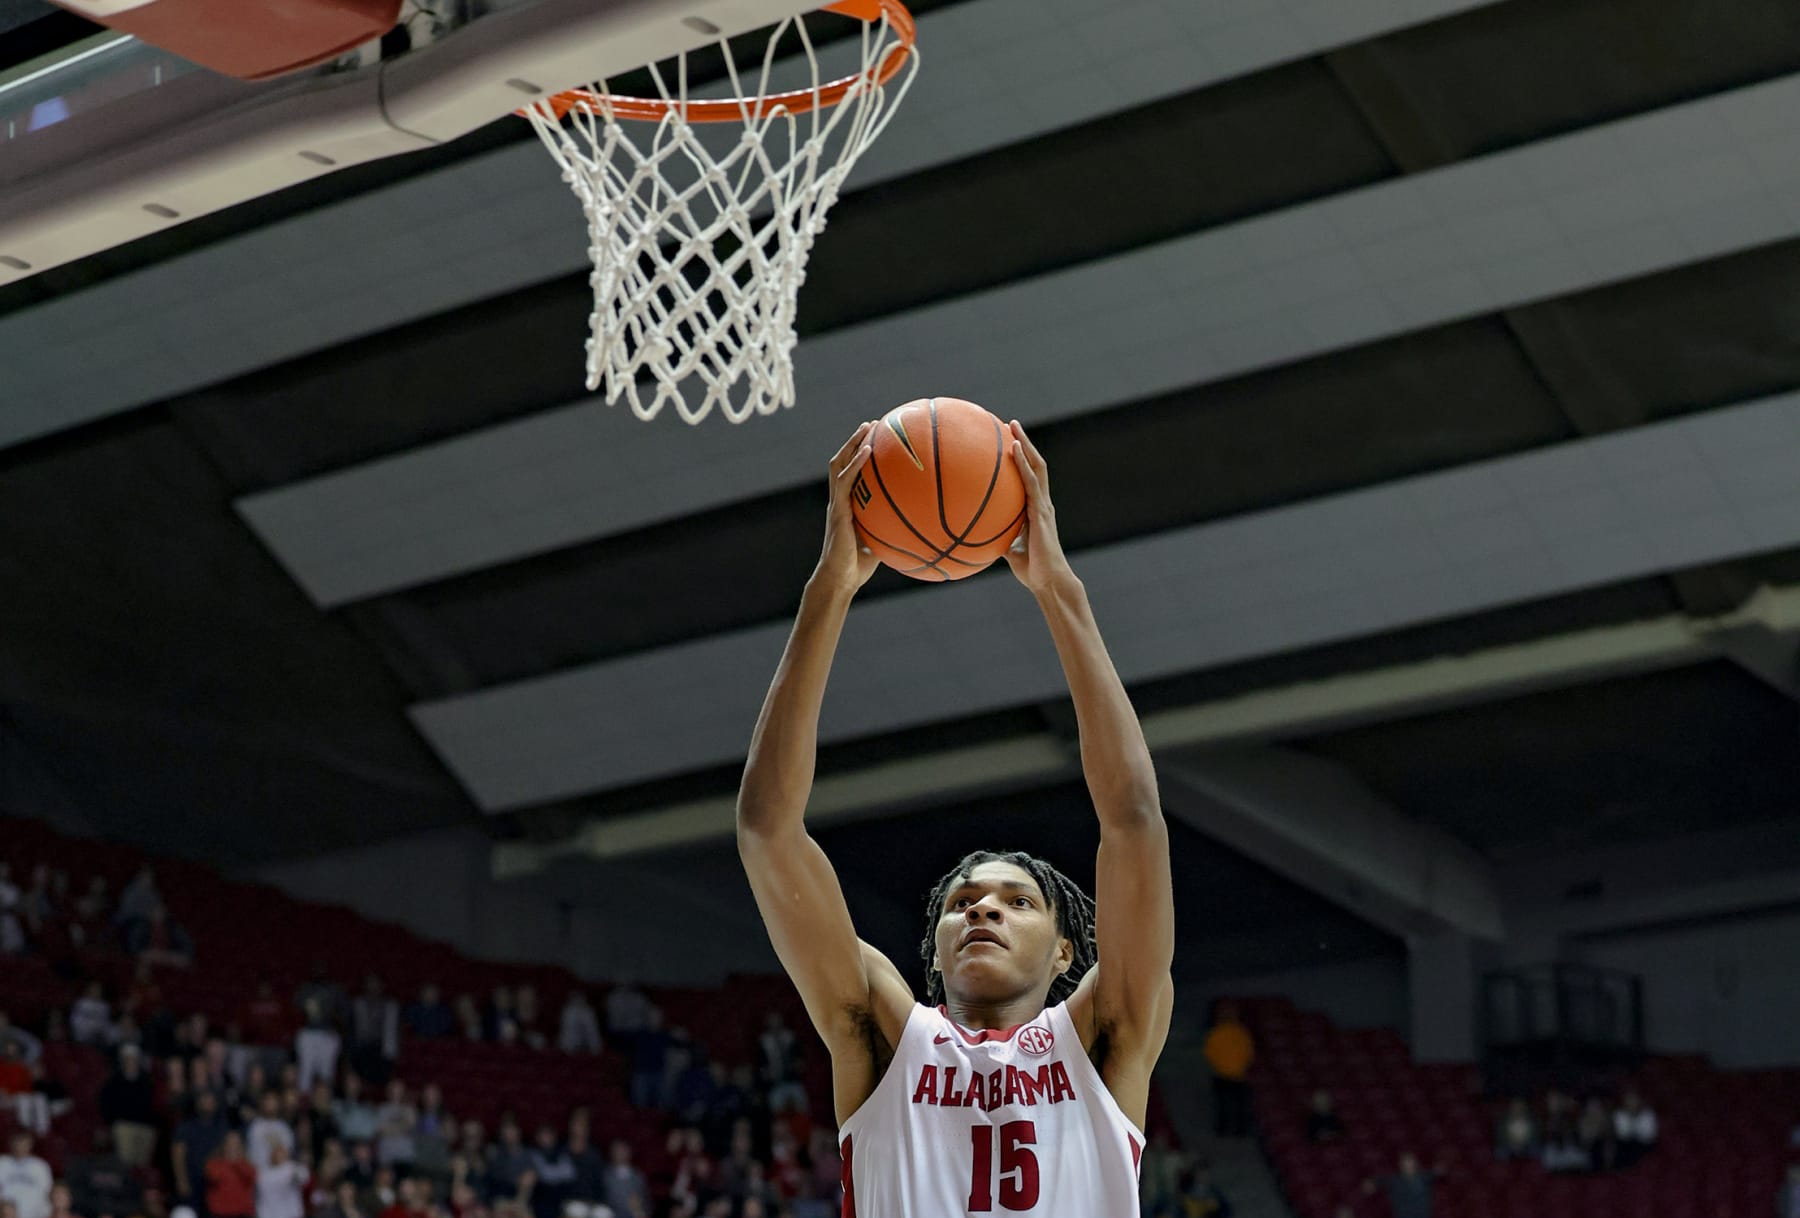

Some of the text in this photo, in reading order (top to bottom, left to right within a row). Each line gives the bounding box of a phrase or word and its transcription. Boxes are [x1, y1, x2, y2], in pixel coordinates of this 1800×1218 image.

[1019, 1026, 1053, 1054] SEC
[912, 1061, 1076, 1112] ALABAMA
[968, 1120, 1040, 1212] 15
